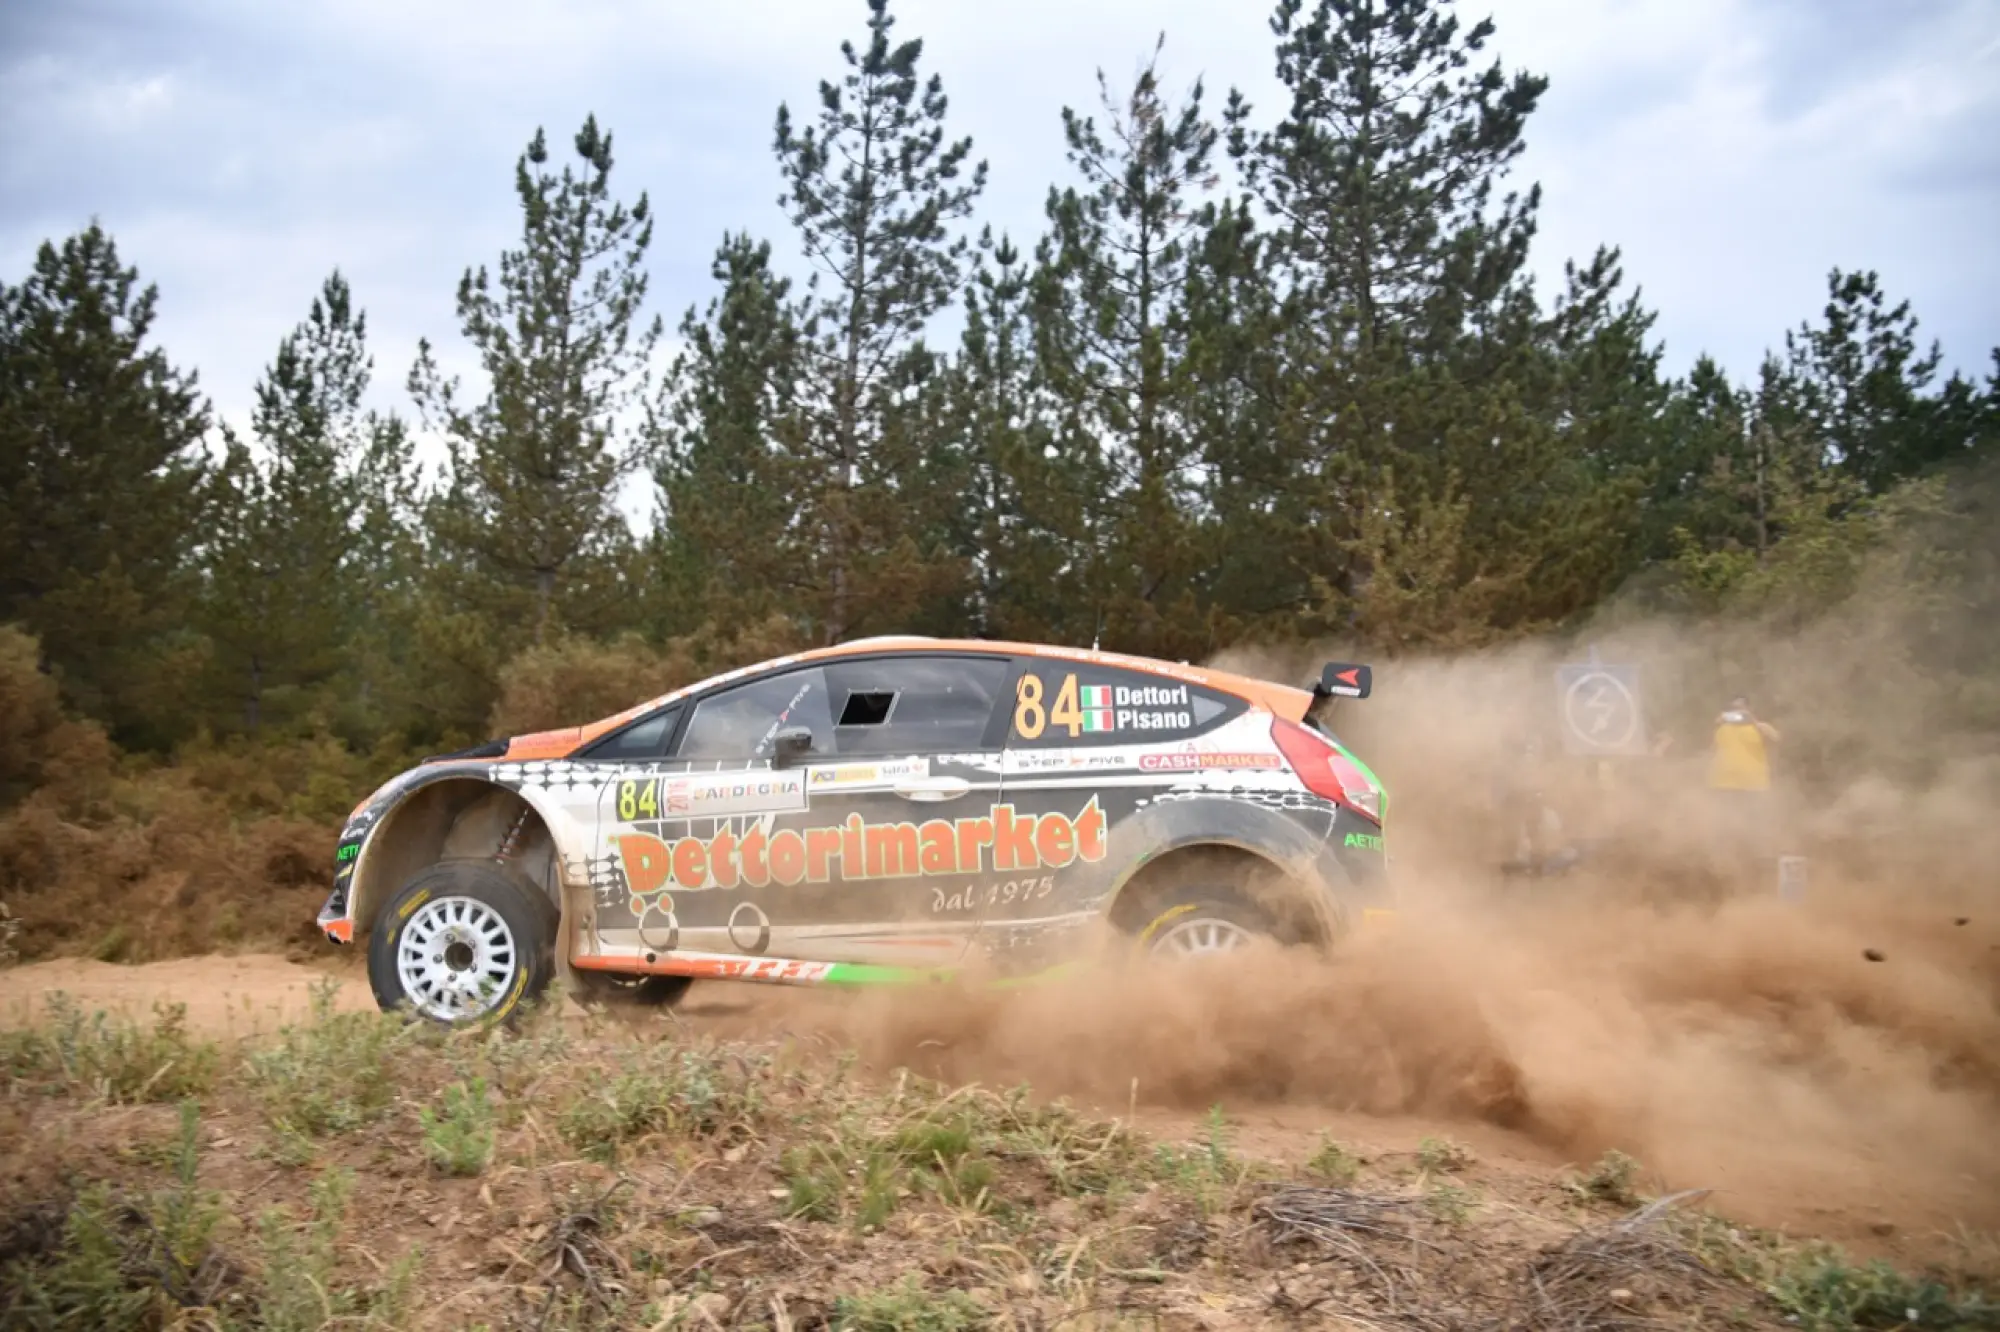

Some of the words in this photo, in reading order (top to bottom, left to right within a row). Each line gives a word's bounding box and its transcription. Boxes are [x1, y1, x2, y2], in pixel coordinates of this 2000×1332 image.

[1015, 673, 1084, 739] 84
[1115, 685, 1188, 706] Dettori
[1116, 710, 1190, 730] Pisano
[619, 780, 657, 820] 84
[693, 781, 799, 801] SARDEGNA
[608, 793, 1107, 895] Dettorimarket
[932, 885, 975, 912] dal
[986, 876, 1054, 905] 1975
